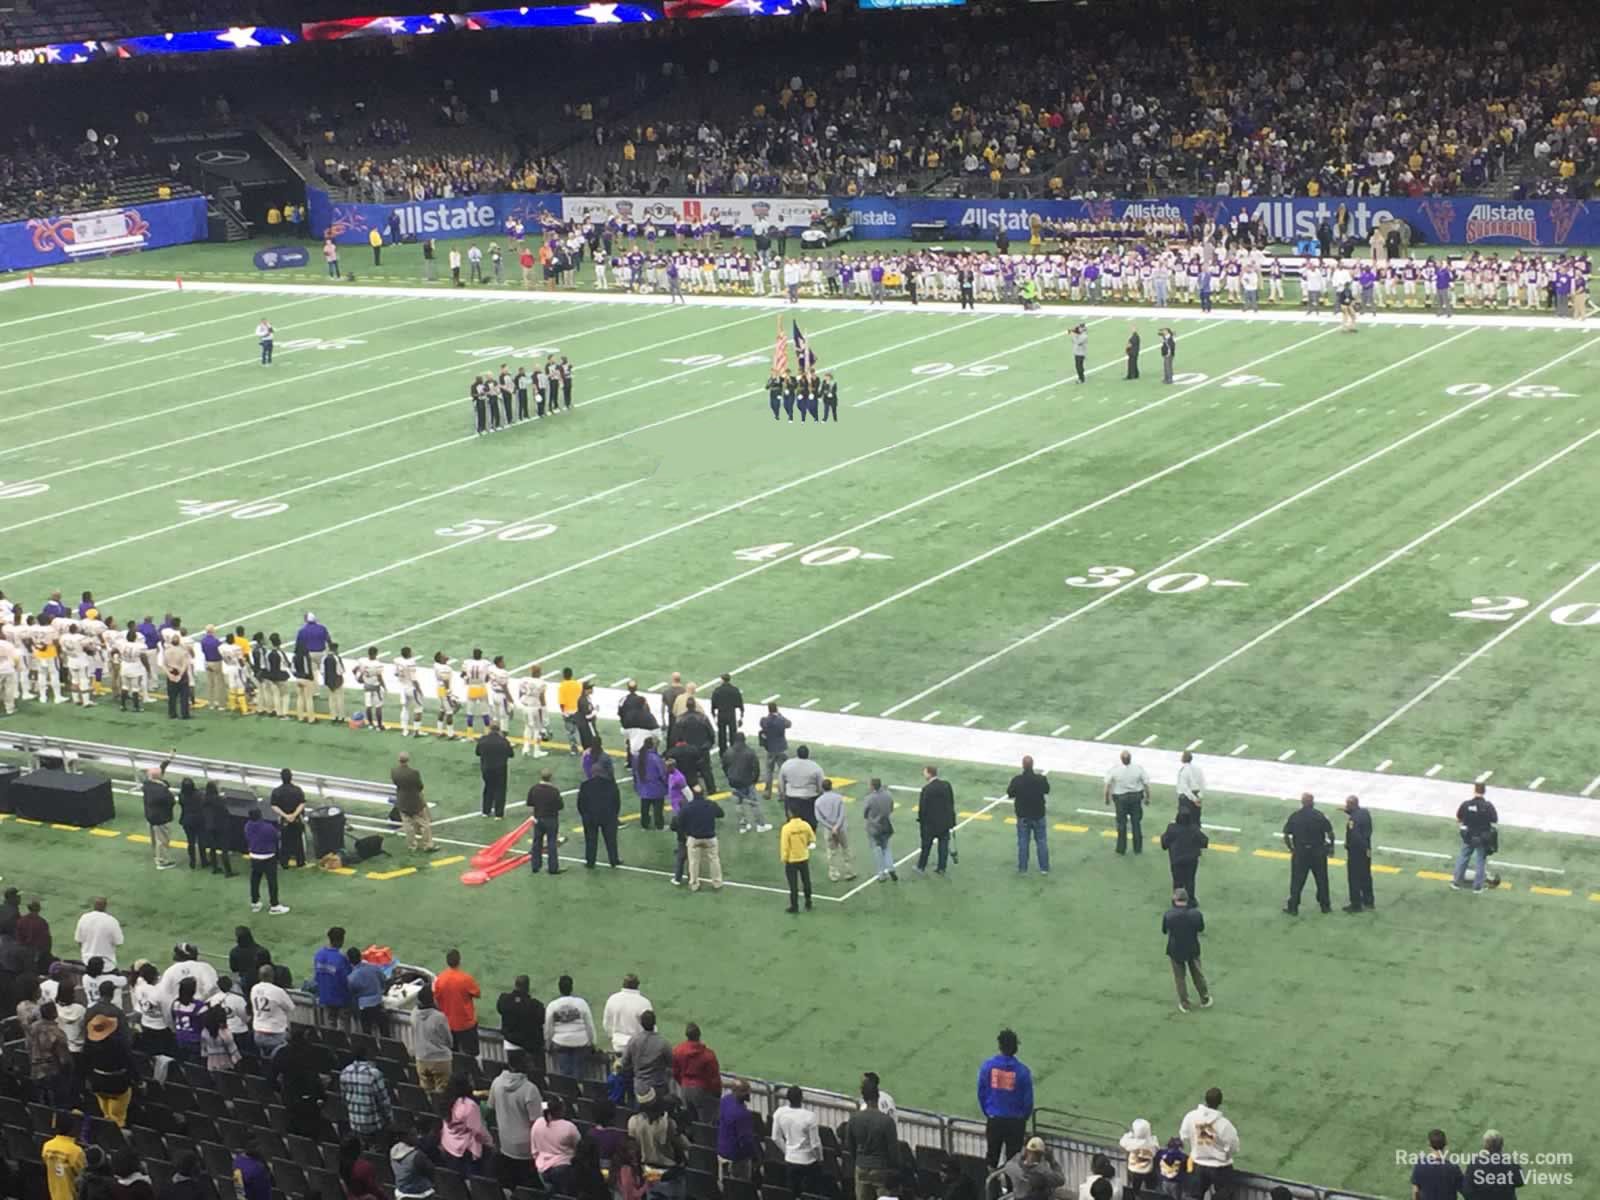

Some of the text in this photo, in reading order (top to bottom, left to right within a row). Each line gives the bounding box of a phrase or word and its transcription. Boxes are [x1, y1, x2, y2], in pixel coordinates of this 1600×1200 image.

[383, 201, 495, 235] Allstate
[1123, 203, 1181, 218] Allstate
[1469, 204, 1535, 220] Allstate
[254, 995, 271, 1012] 12
